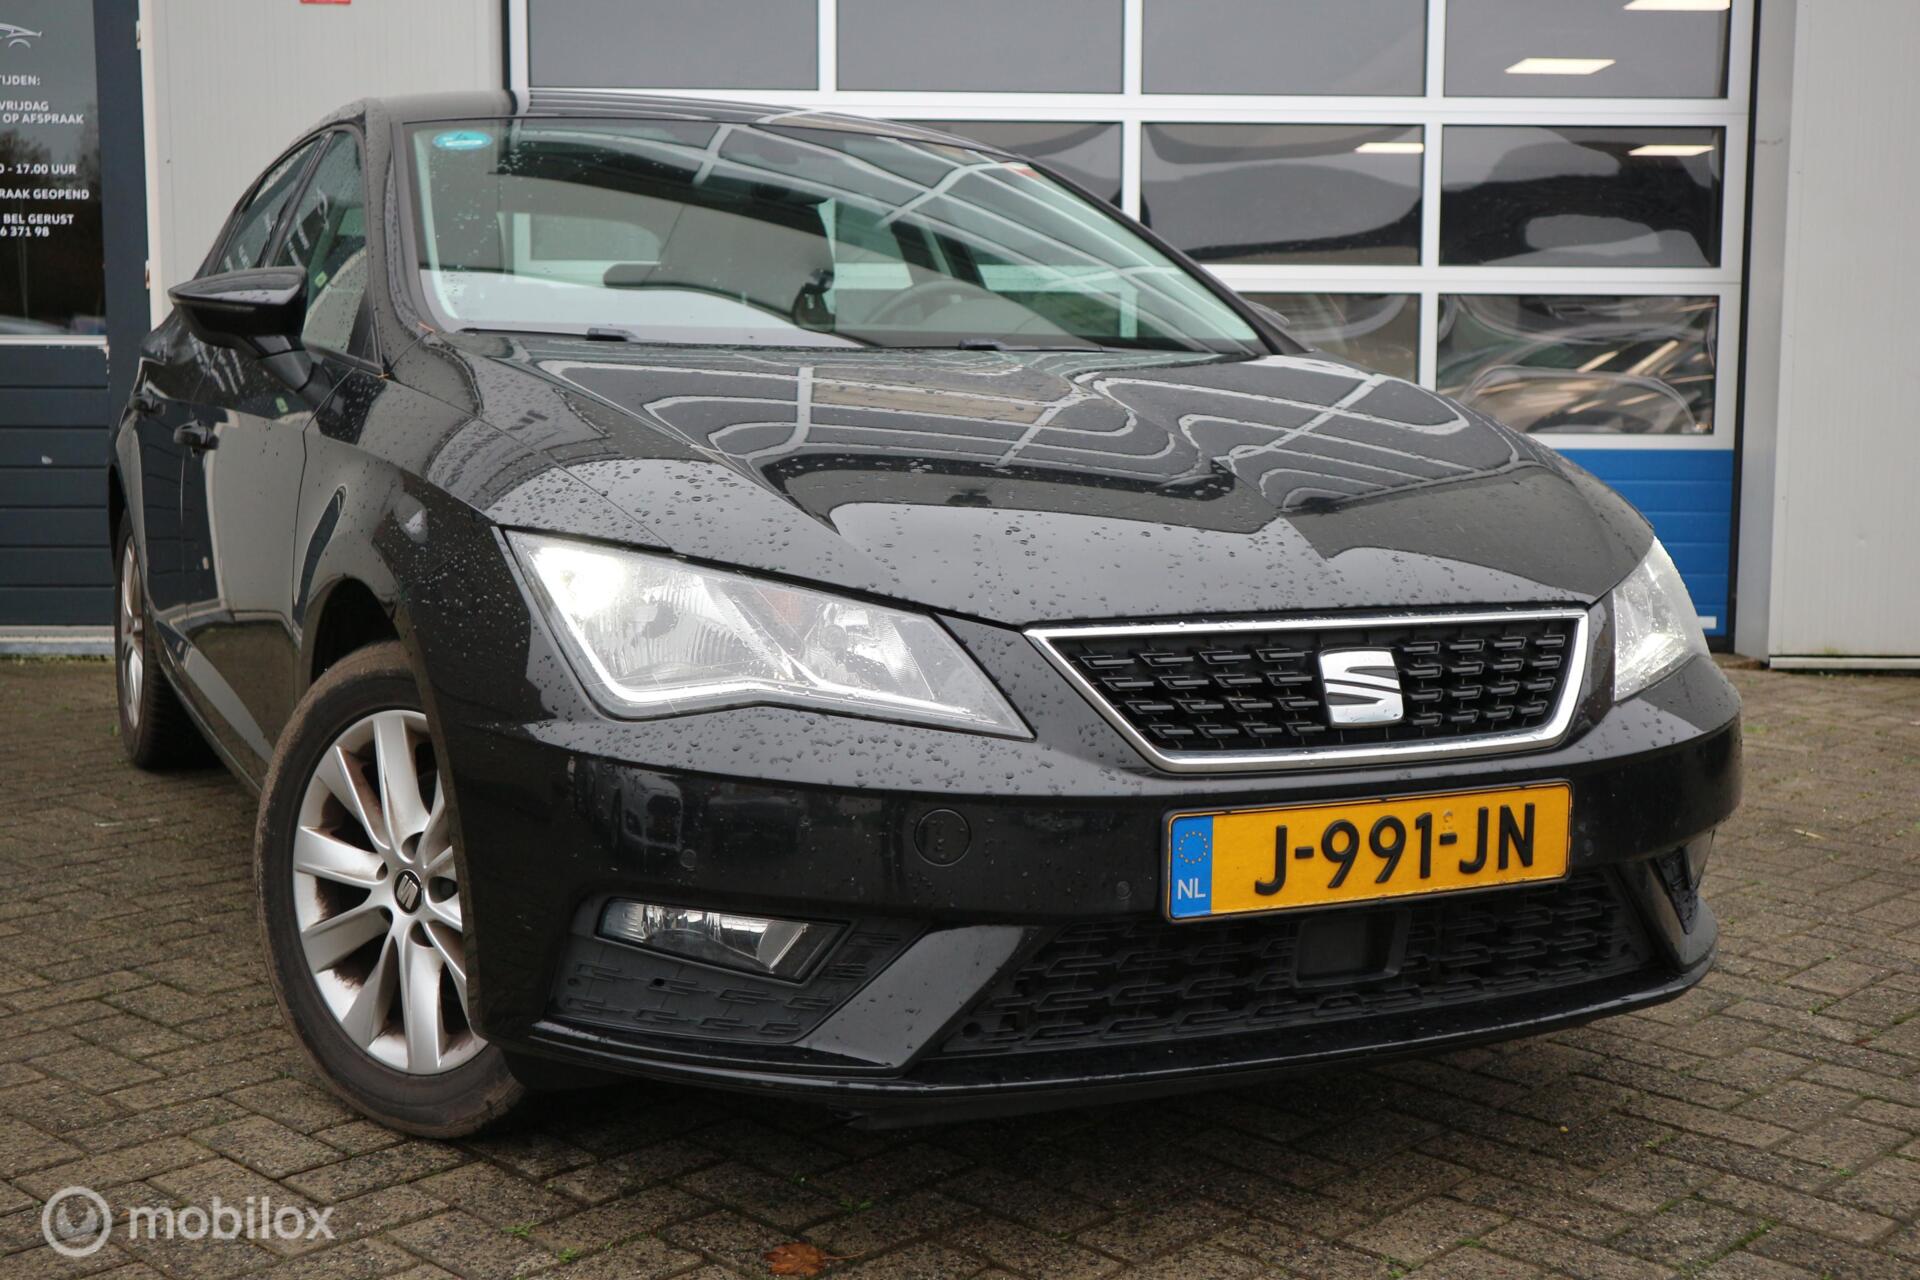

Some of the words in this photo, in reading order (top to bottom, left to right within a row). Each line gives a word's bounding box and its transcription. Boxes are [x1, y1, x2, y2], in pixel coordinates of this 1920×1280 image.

[0, 75, 40, 86] IJDEN:
[3, 113, 19, 124] OP
[22, 114, 84, 124] AFSPRAAK
[16, 164, 48, 174] 17.00
[51, 164, 77, 175] UUR
[33, 188, 90, 200] GEOPEND
[3, 213, 26, 225] BEL
[28, 213, 74, 225] GERUST
[10, 226, 32, 237] 371
[35, 226, 50, 237] 98
[1254, 803, 1536, 896] J-991-JN
[1177, 878, 1206, 900] NL
